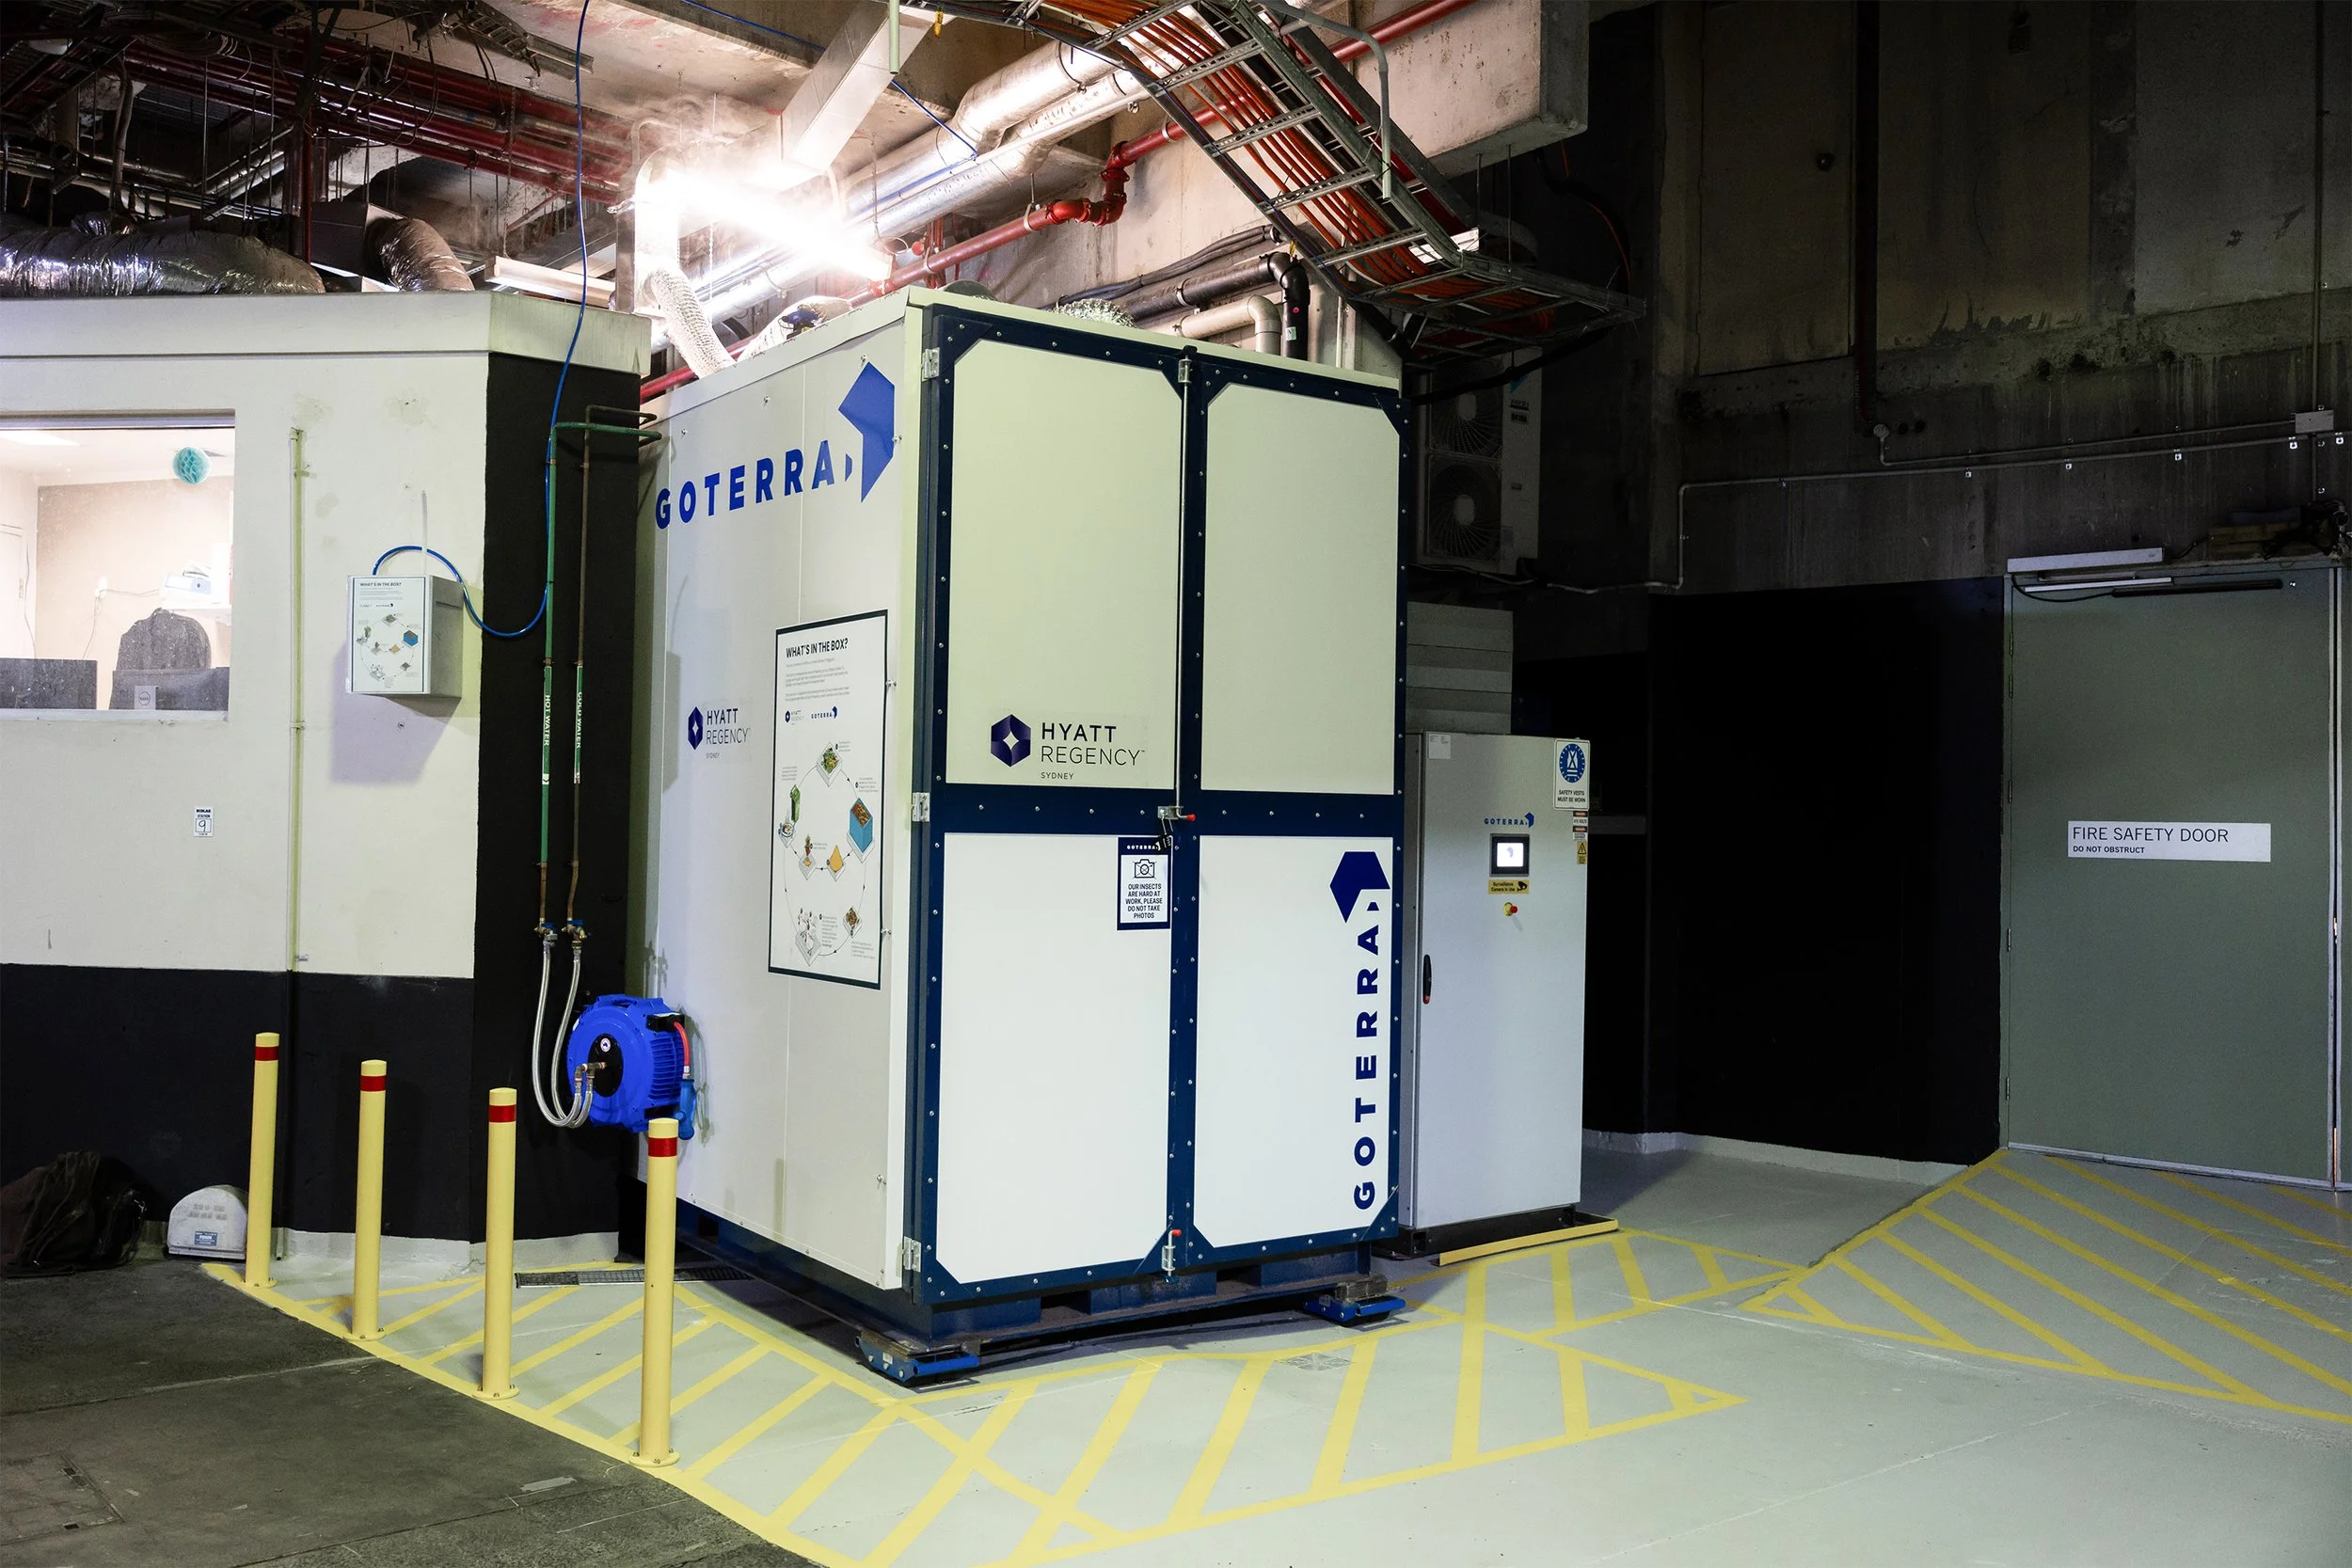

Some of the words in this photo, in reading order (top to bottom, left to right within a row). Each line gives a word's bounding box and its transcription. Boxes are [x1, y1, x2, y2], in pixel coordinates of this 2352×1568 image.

[656, 439, 834, 530] GOTERRA
[787, 644, 809, 657] WHAT'S
[811, 643, 817, 654] IN
[818, 641, 830, 653] THE
[832, 638, 849, 651] BOX?
[707, 708, 738, 725] HYATT
[707, 728, 750, 744] REGENCY
[1041, 722, 1117, 742] HYATT
[199, 820, 206, 832] 9
[1484, 817, 1524, 826] GOTERRA
[2073, 827, 2107, 840] FIRE
[2114, 828, 2173, 841] SAFETY
[2181, 829, 2229, 843] DOOR
[1353, 924, 1379, 1211] GOTERRA
